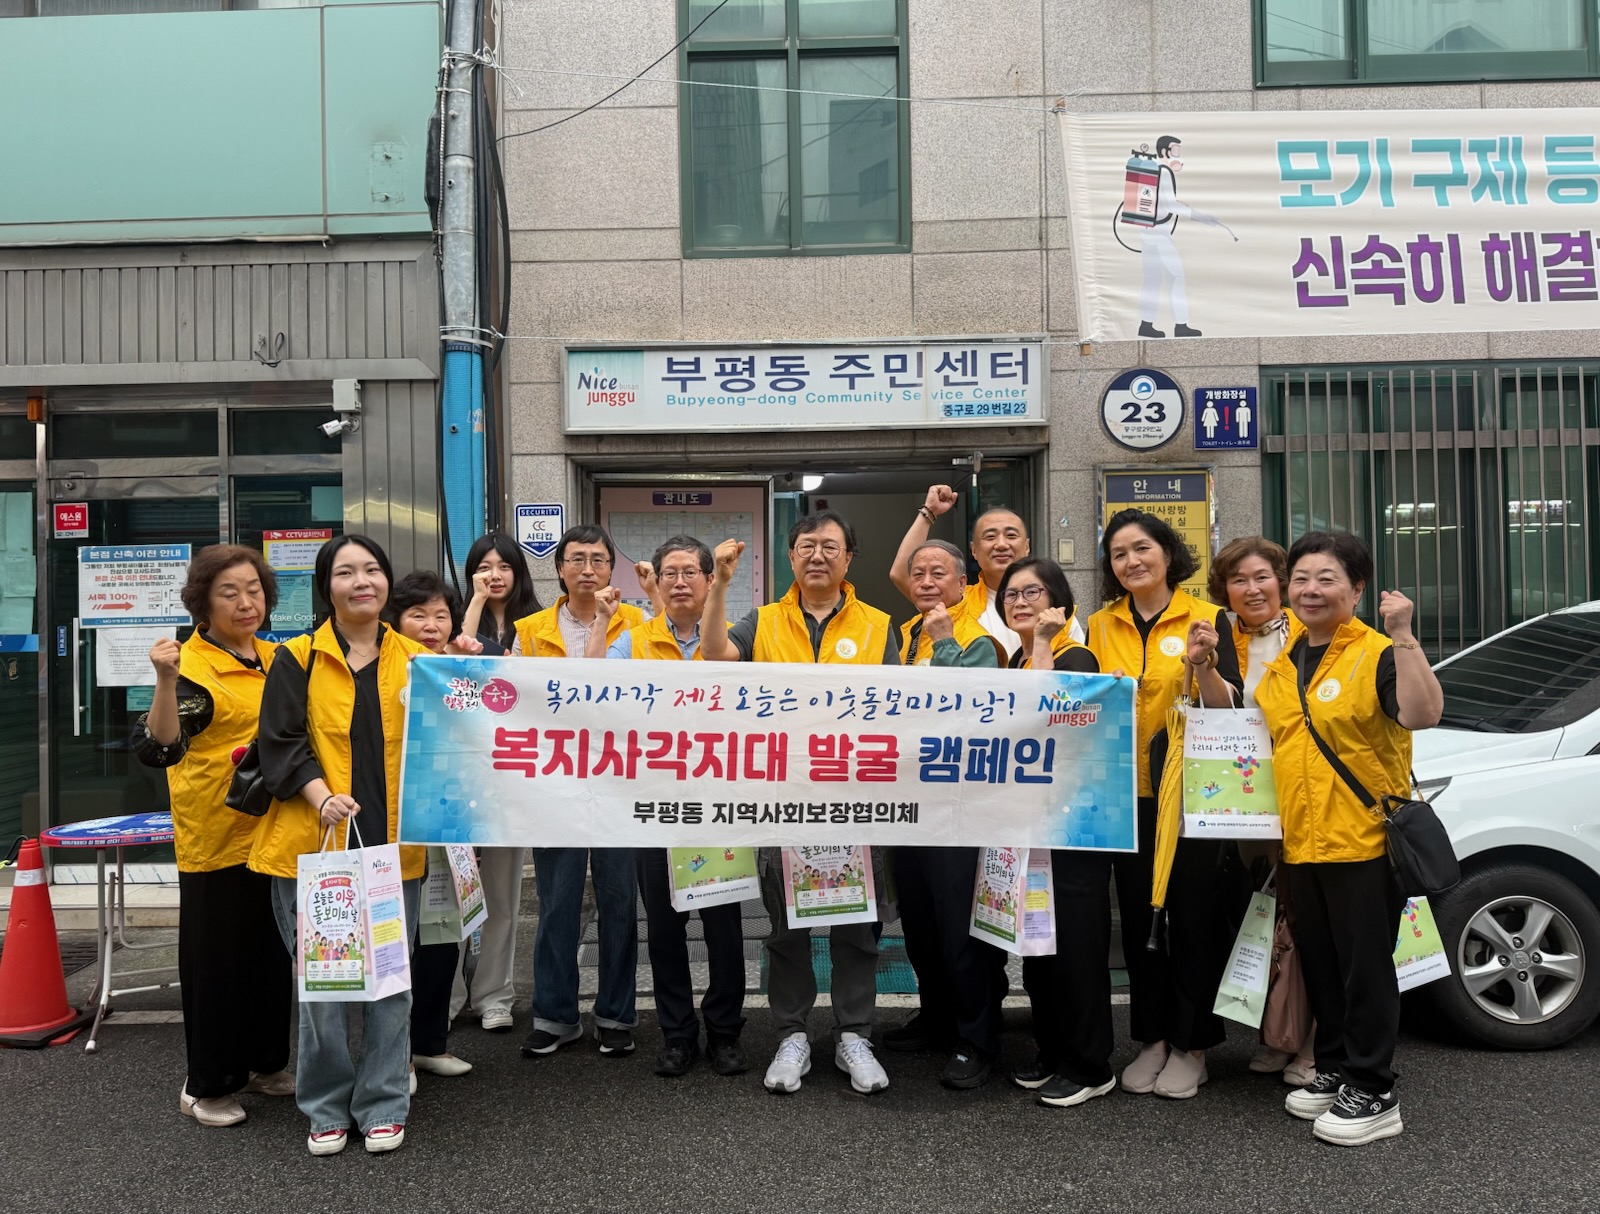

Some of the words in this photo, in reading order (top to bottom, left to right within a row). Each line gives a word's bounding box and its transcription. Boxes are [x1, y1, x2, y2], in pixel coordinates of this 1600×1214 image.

[1277, 138, 1395, 207] 모기
[1411, 136, 1528, 207] 구제
[1544, 136, 1600, 204] 등
[1292, 233, 1465, 307] 신속히
[1480, 230, 1600, 303] 해결
[661, 355, 810, 393] 부평동
[829, 351, 923, 391] 주민
[934, 348, 1029, 387] 센터
[577, 372, 617, 390] Nice
[587, 391, 635, 406] junggu
[666, 394, 797, 407] Bupyeong-dong
[805, 391, 893, 403] Community
[902, 389, 963, 401] Sevice
[973, 387, 1027, 399] Center
[1205, 390, 1247, 400] 개방화장실
[943, 404, 974, 417] 중구로
[977, 404, 990, 415] 29
[991, 403, 1012, 415] 번길
[1013, 402, 1027, 414] 23
[1120, 402, 1166, 423] 23
[664, 493, 700, 504] 관내도
[60, 512, 82, 521] 에스원
[90, 551, 110, 559] 본점
[113, 550, 133, 558] 신축
[136, 549, 157, 558] 이전
[160, 549, 181, 557] 안내
[88, 593, 106, 601] 서쪽
[269, 613, 292, 622] Make
[293, 613, 316, 621] Good
[547, 680, 663, 715] 복지사각
[673, 684, 725, 712] 제로
[735, 685, 798, 718] 오늘은
[809, 686, 962, 721] 이웃돌보미의
[972, 690, 1016, 723] 날!
[1038, 694, 1082, 712] Nice
[1081, 703, 1101, 711] busan
[1047, 712, 1096, 727] junggu
[491, 726, 789, 782] 복지사각지대
[808, 732, 900, 783] 발굴
[918, 735, 1056, 784] 캠페인
[633, 801, 704, 824] 부평동
[711, 801, 919, 824] 지역사회보장협의체
[313, 890, 334, 906] 오늘은
[336, 889, 356, 908] 이웃
[313, 905, 349, 925] 돌보미의
[351, 908, 359, 923] 날
